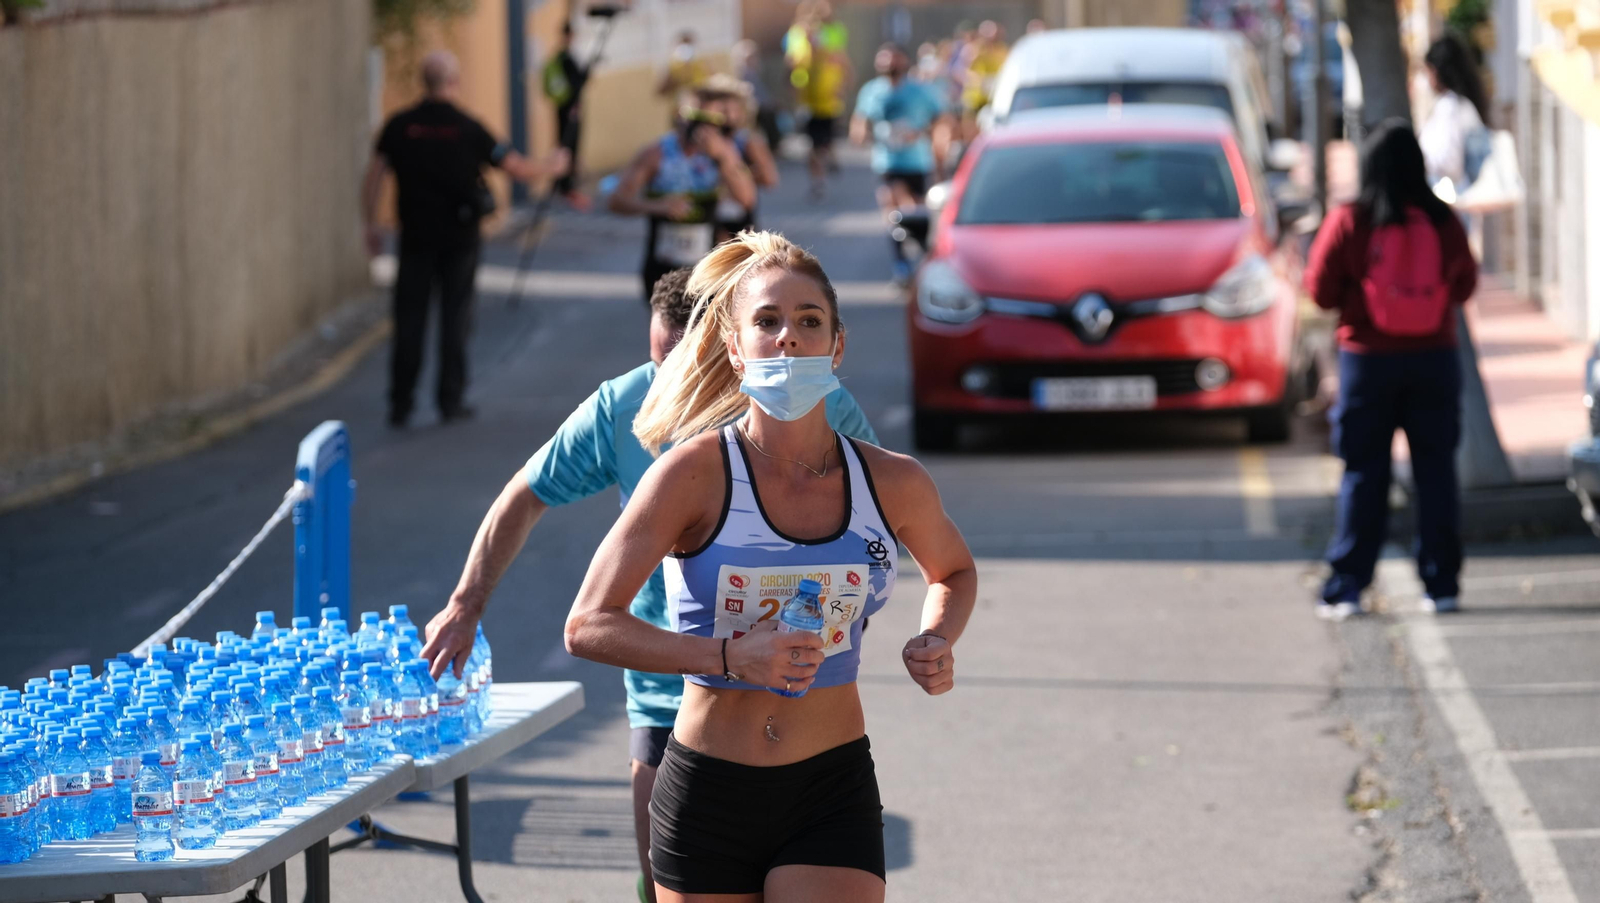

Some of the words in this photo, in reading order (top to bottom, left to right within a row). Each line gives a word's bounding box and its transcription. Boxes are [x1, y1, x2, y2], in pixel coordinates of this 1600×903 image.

[760, 574, 804, 588] CIRCUITO
[759, 589, 793, 597] CARRERAS
[728, 602, 741, 611] SN
[830, 600, 844, 615] R
